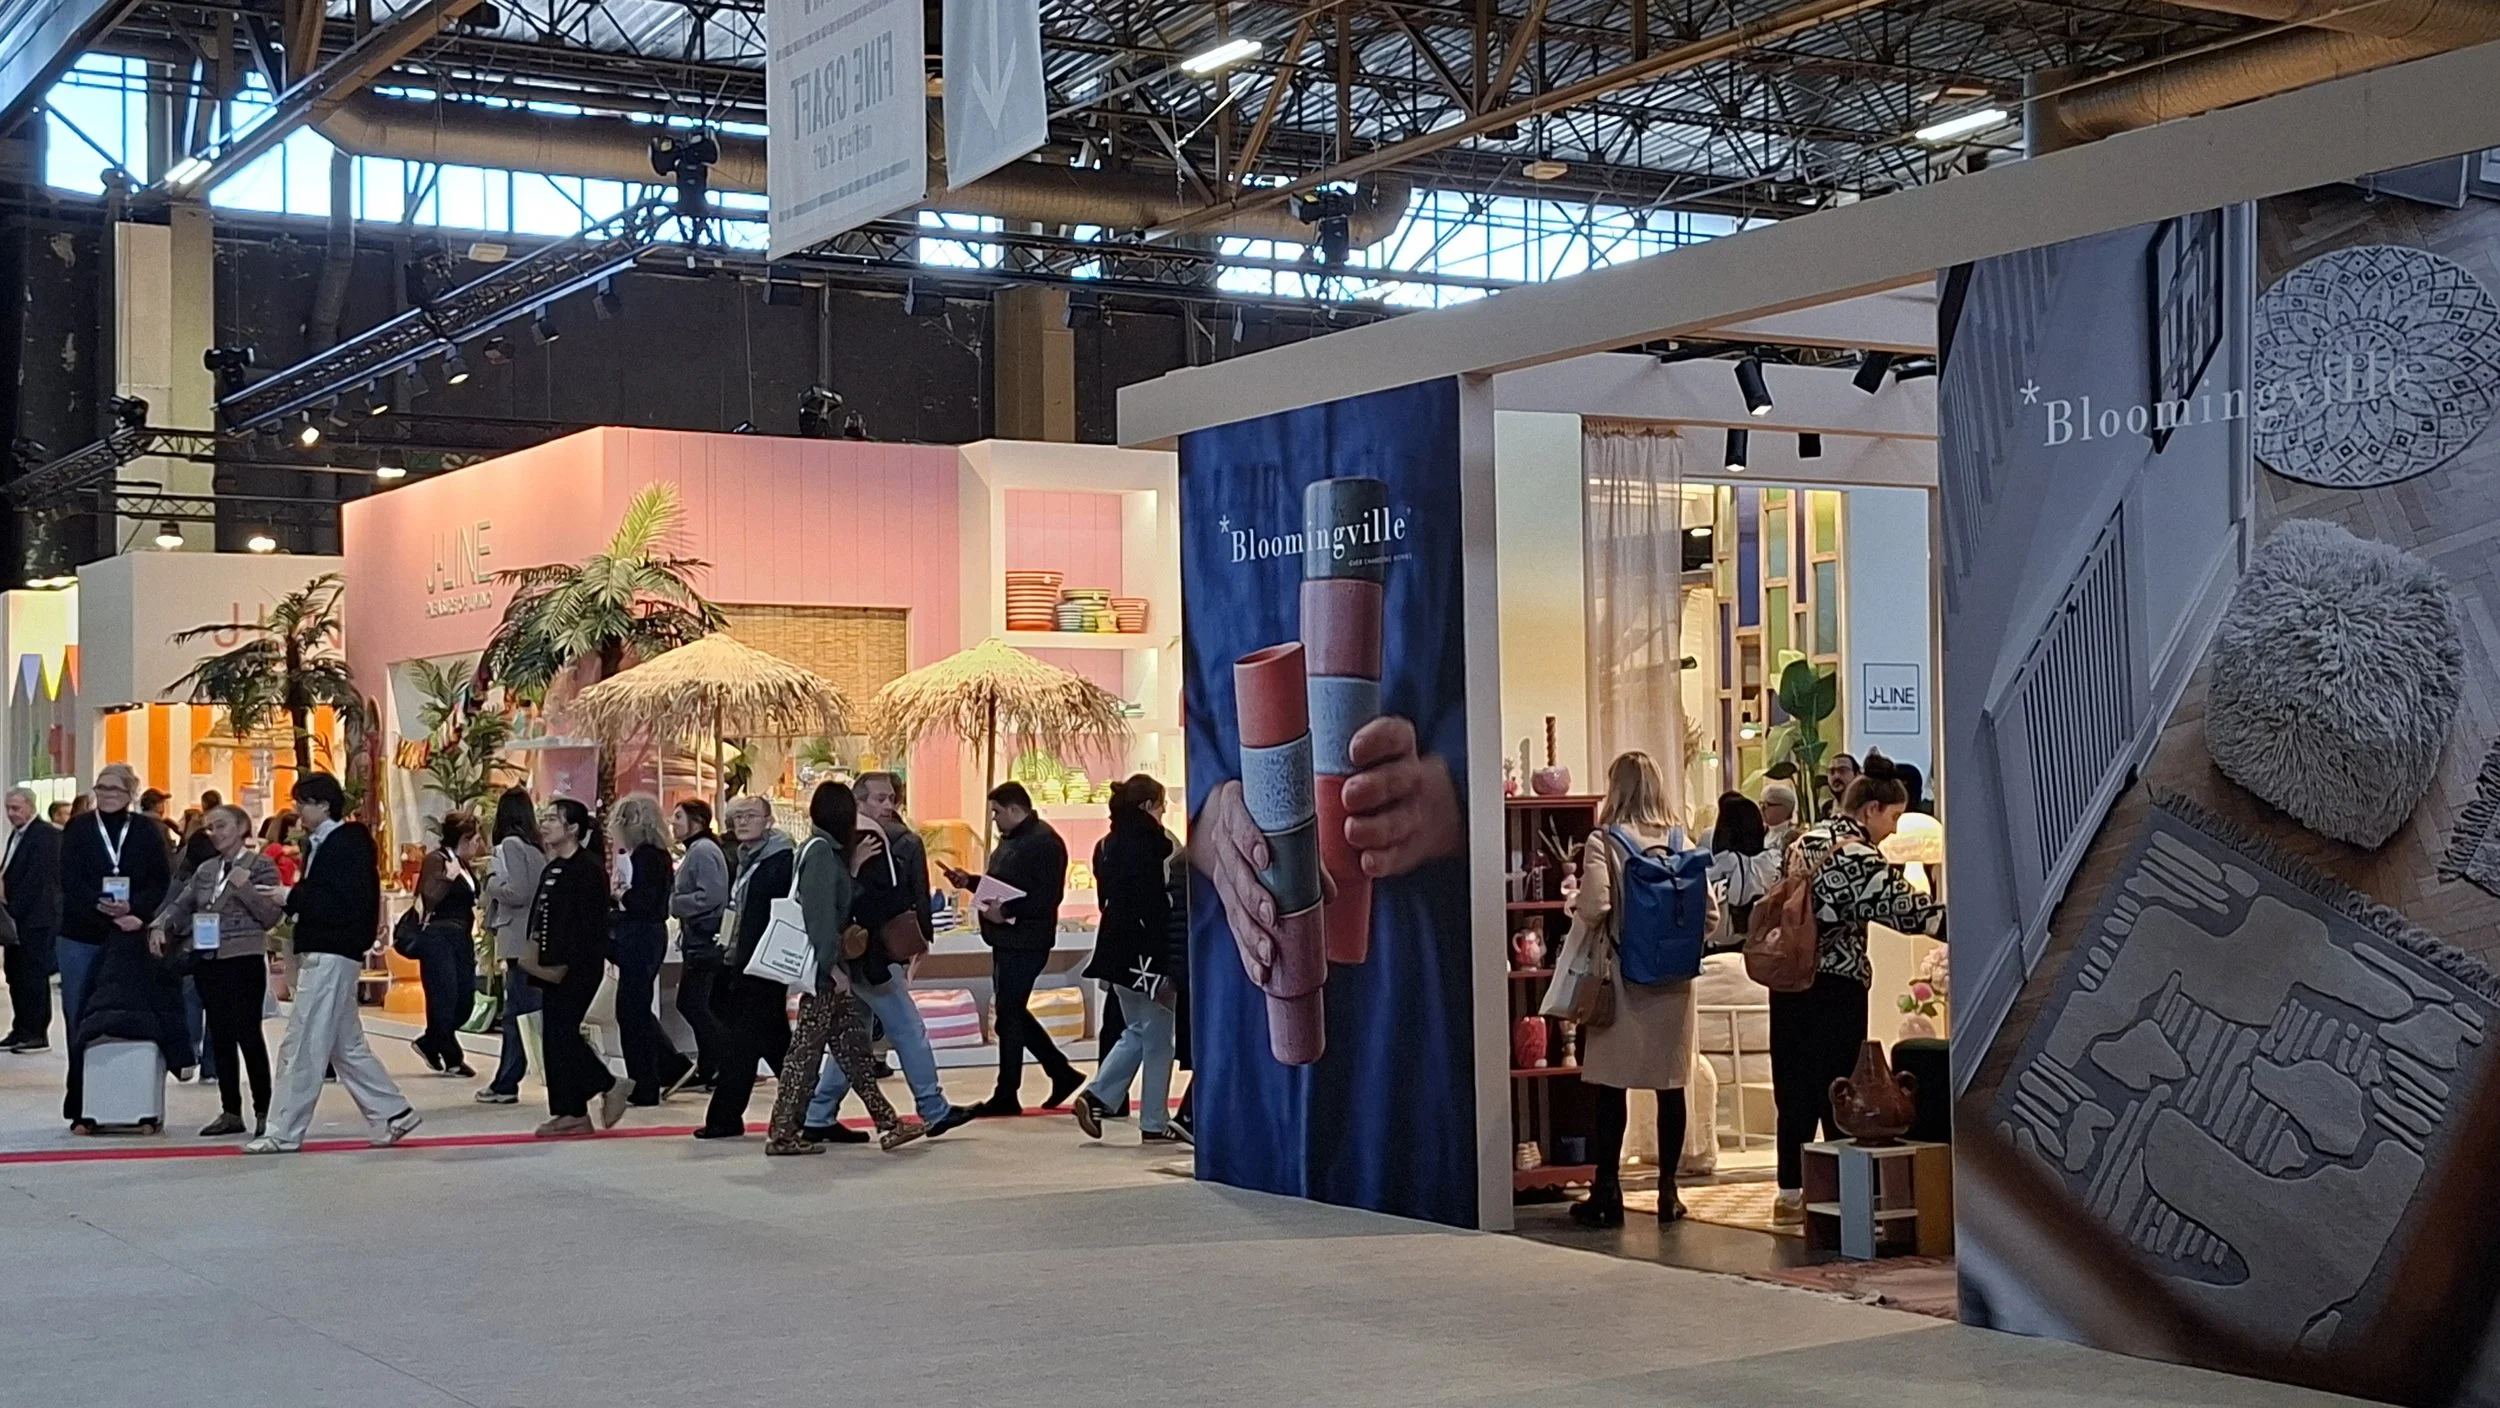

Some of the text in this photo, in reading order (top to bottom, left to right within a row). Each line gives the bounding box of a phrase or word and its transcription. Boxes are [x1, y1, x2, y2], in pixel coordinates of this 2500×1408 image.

[2042, 351, 2410, 447] Bloomingville
[1230, 507, 1407, 563] Bloomingville
[1869, 687, 1915, 704] J-LINE
